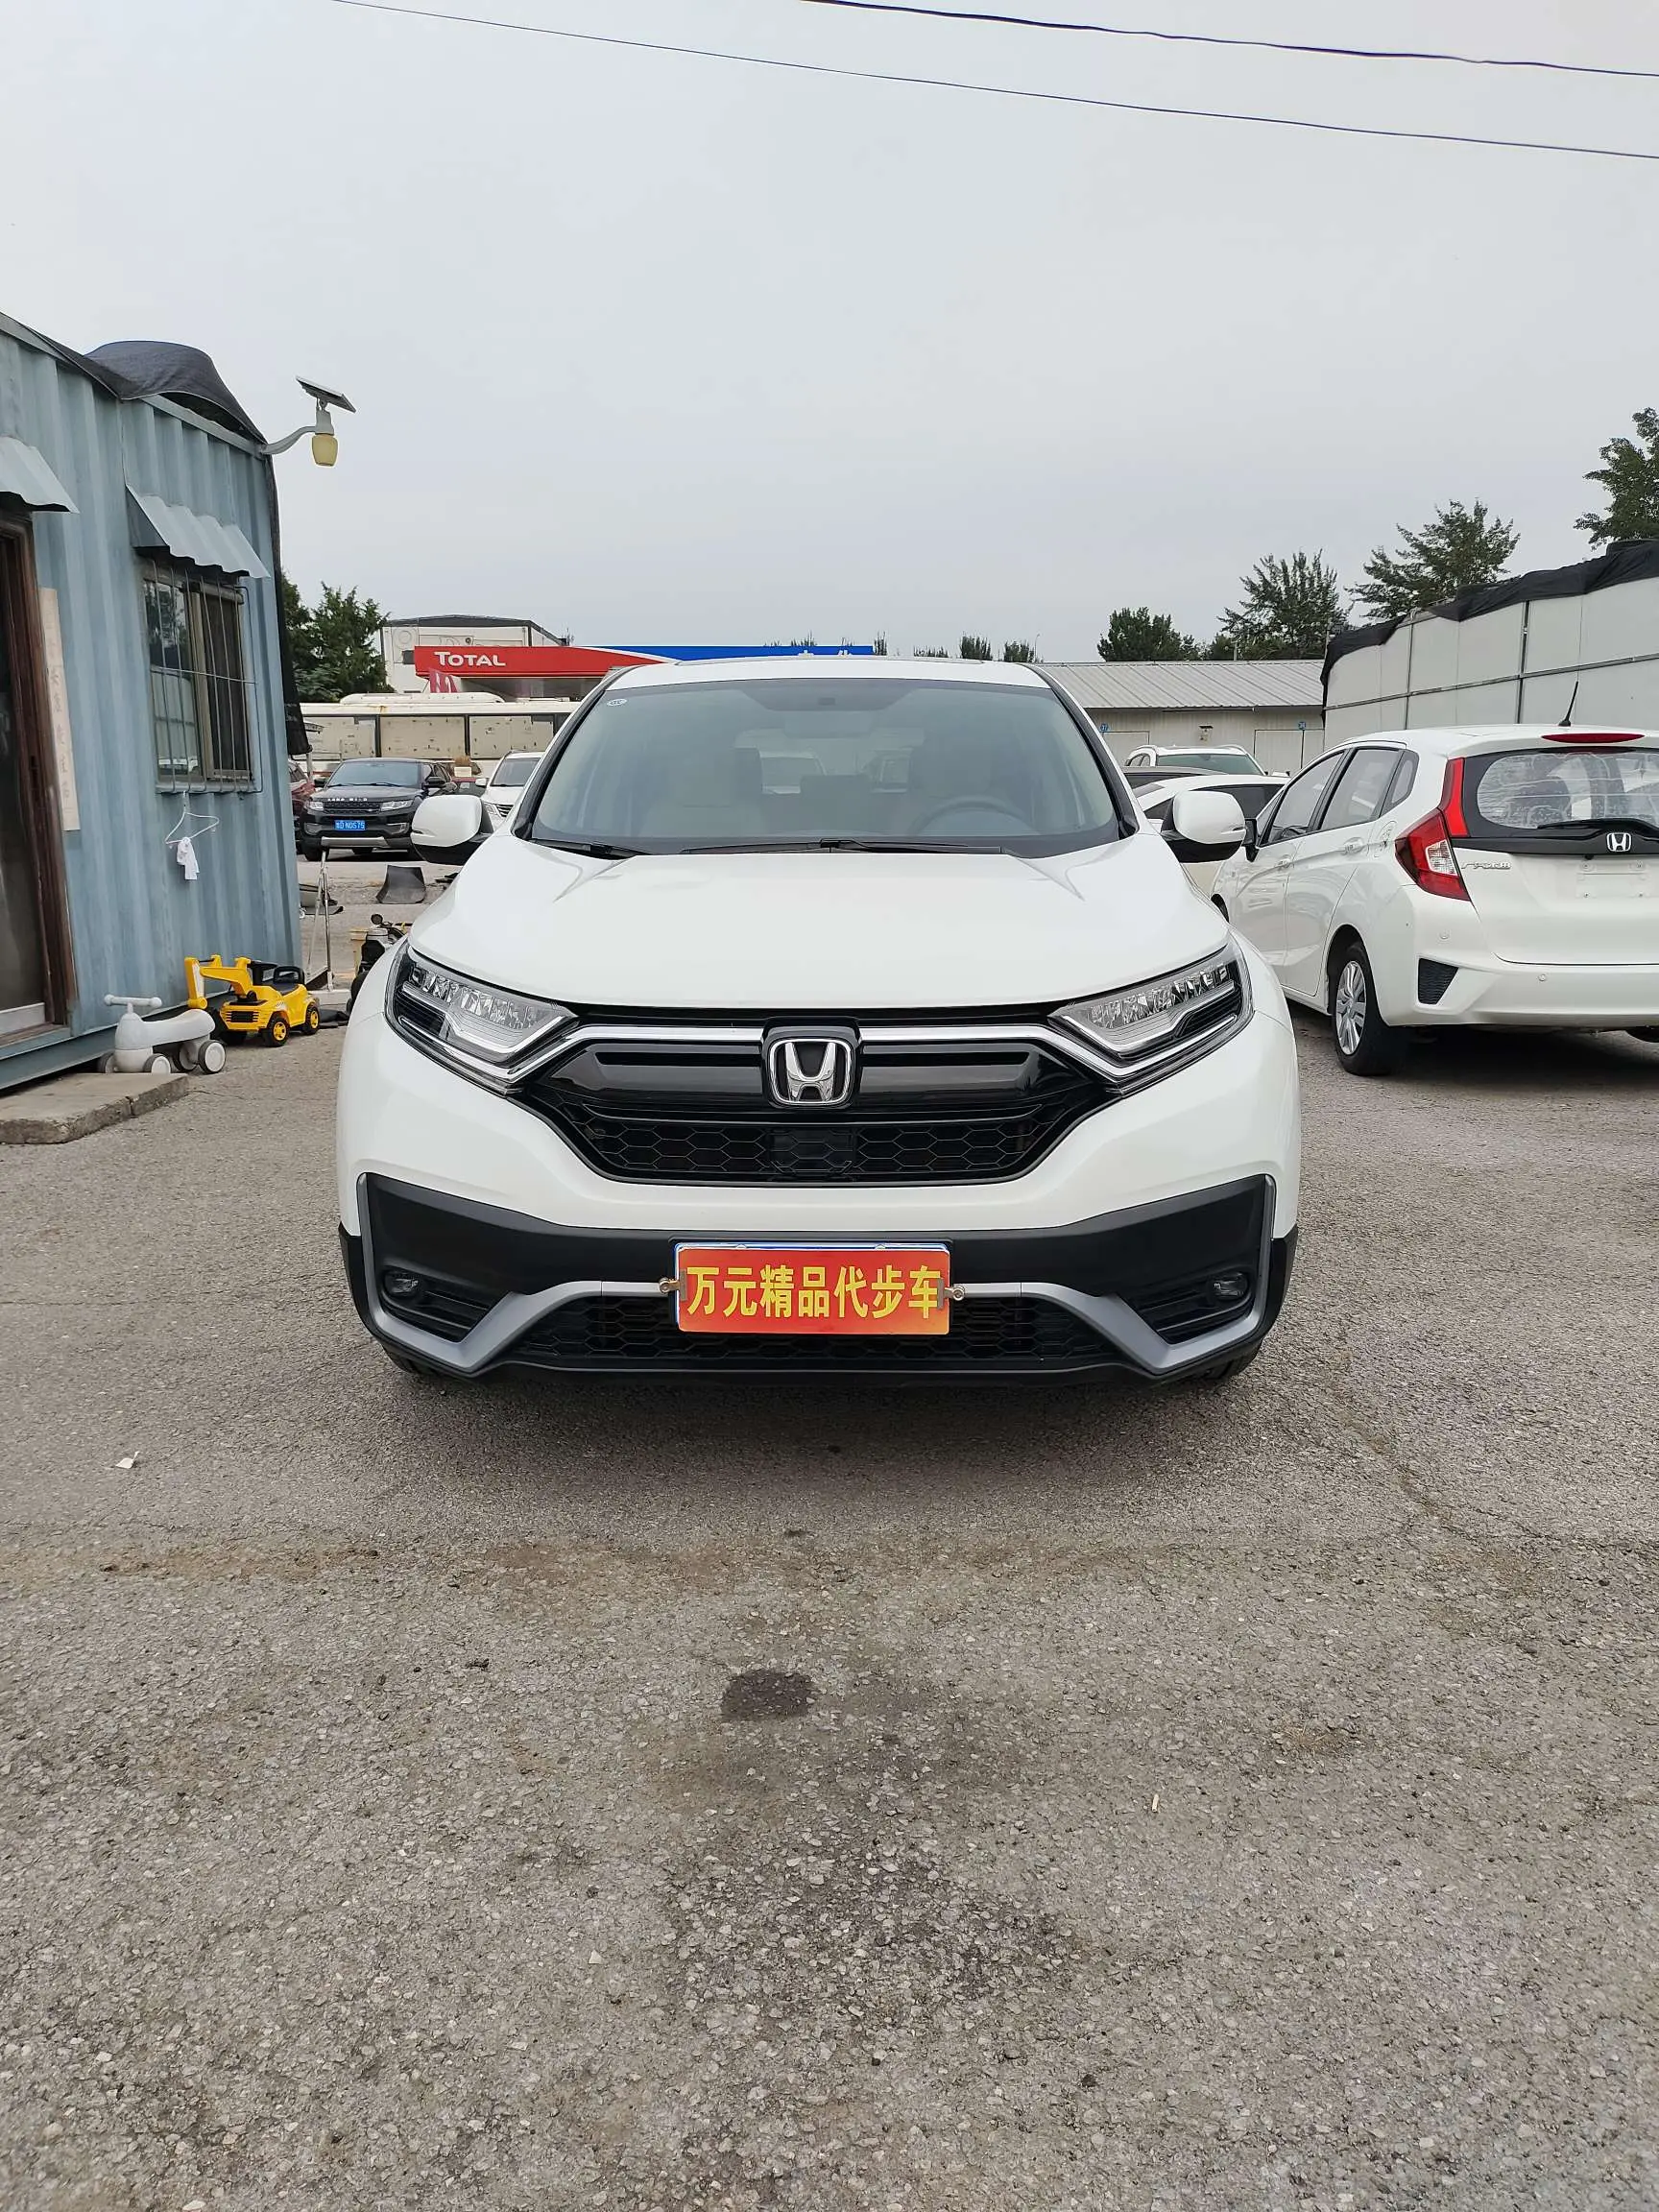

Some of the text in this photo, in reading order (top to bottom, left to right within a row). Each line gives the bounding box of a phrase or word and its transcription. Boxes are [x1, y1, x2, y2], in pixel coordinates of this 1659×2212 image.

[433, 651, 507, 667] TOTAL
[685, 1264, 944, 1319] 万元精品代步车
